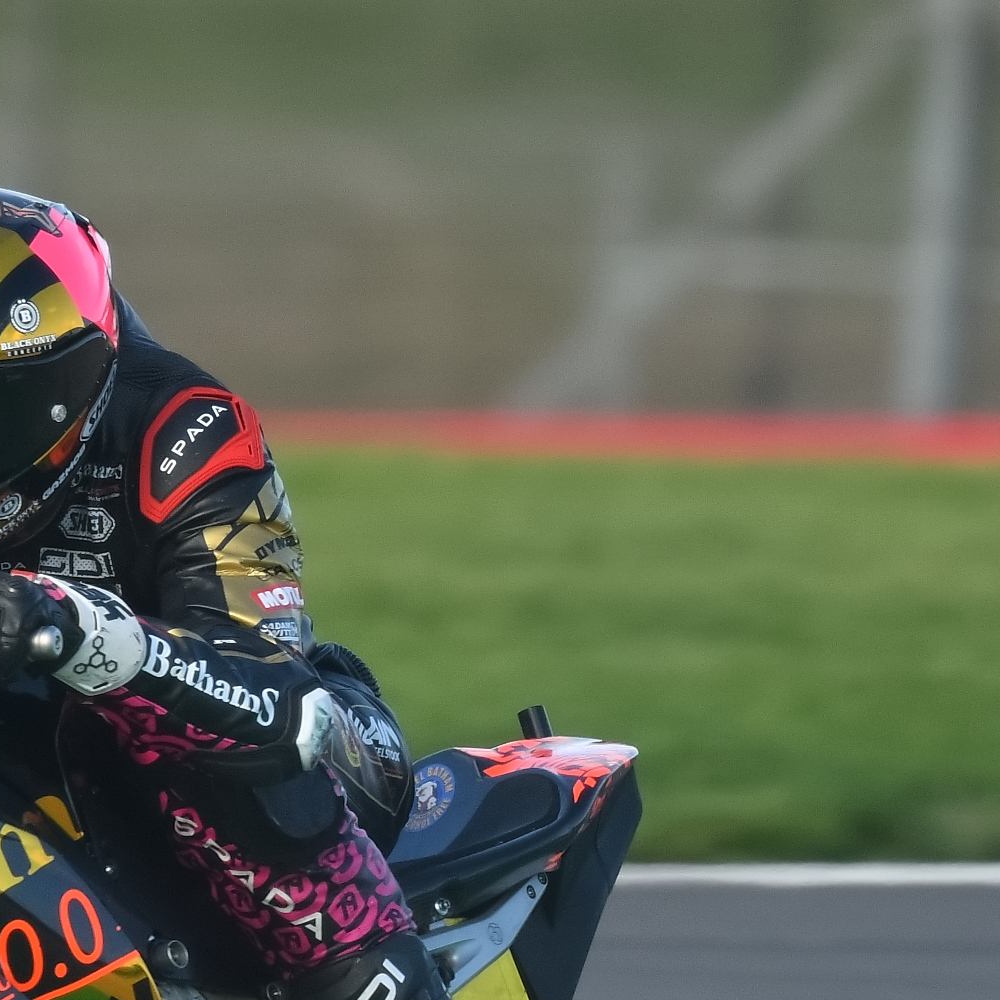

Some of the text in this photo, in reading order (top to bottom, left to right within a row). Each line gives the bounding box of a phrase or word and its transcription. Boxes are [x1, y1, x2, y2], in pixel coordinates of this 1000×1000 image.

[0, 333, 57, 351] BLACK ONYX
[159, 403, 228, 474] SPADA
